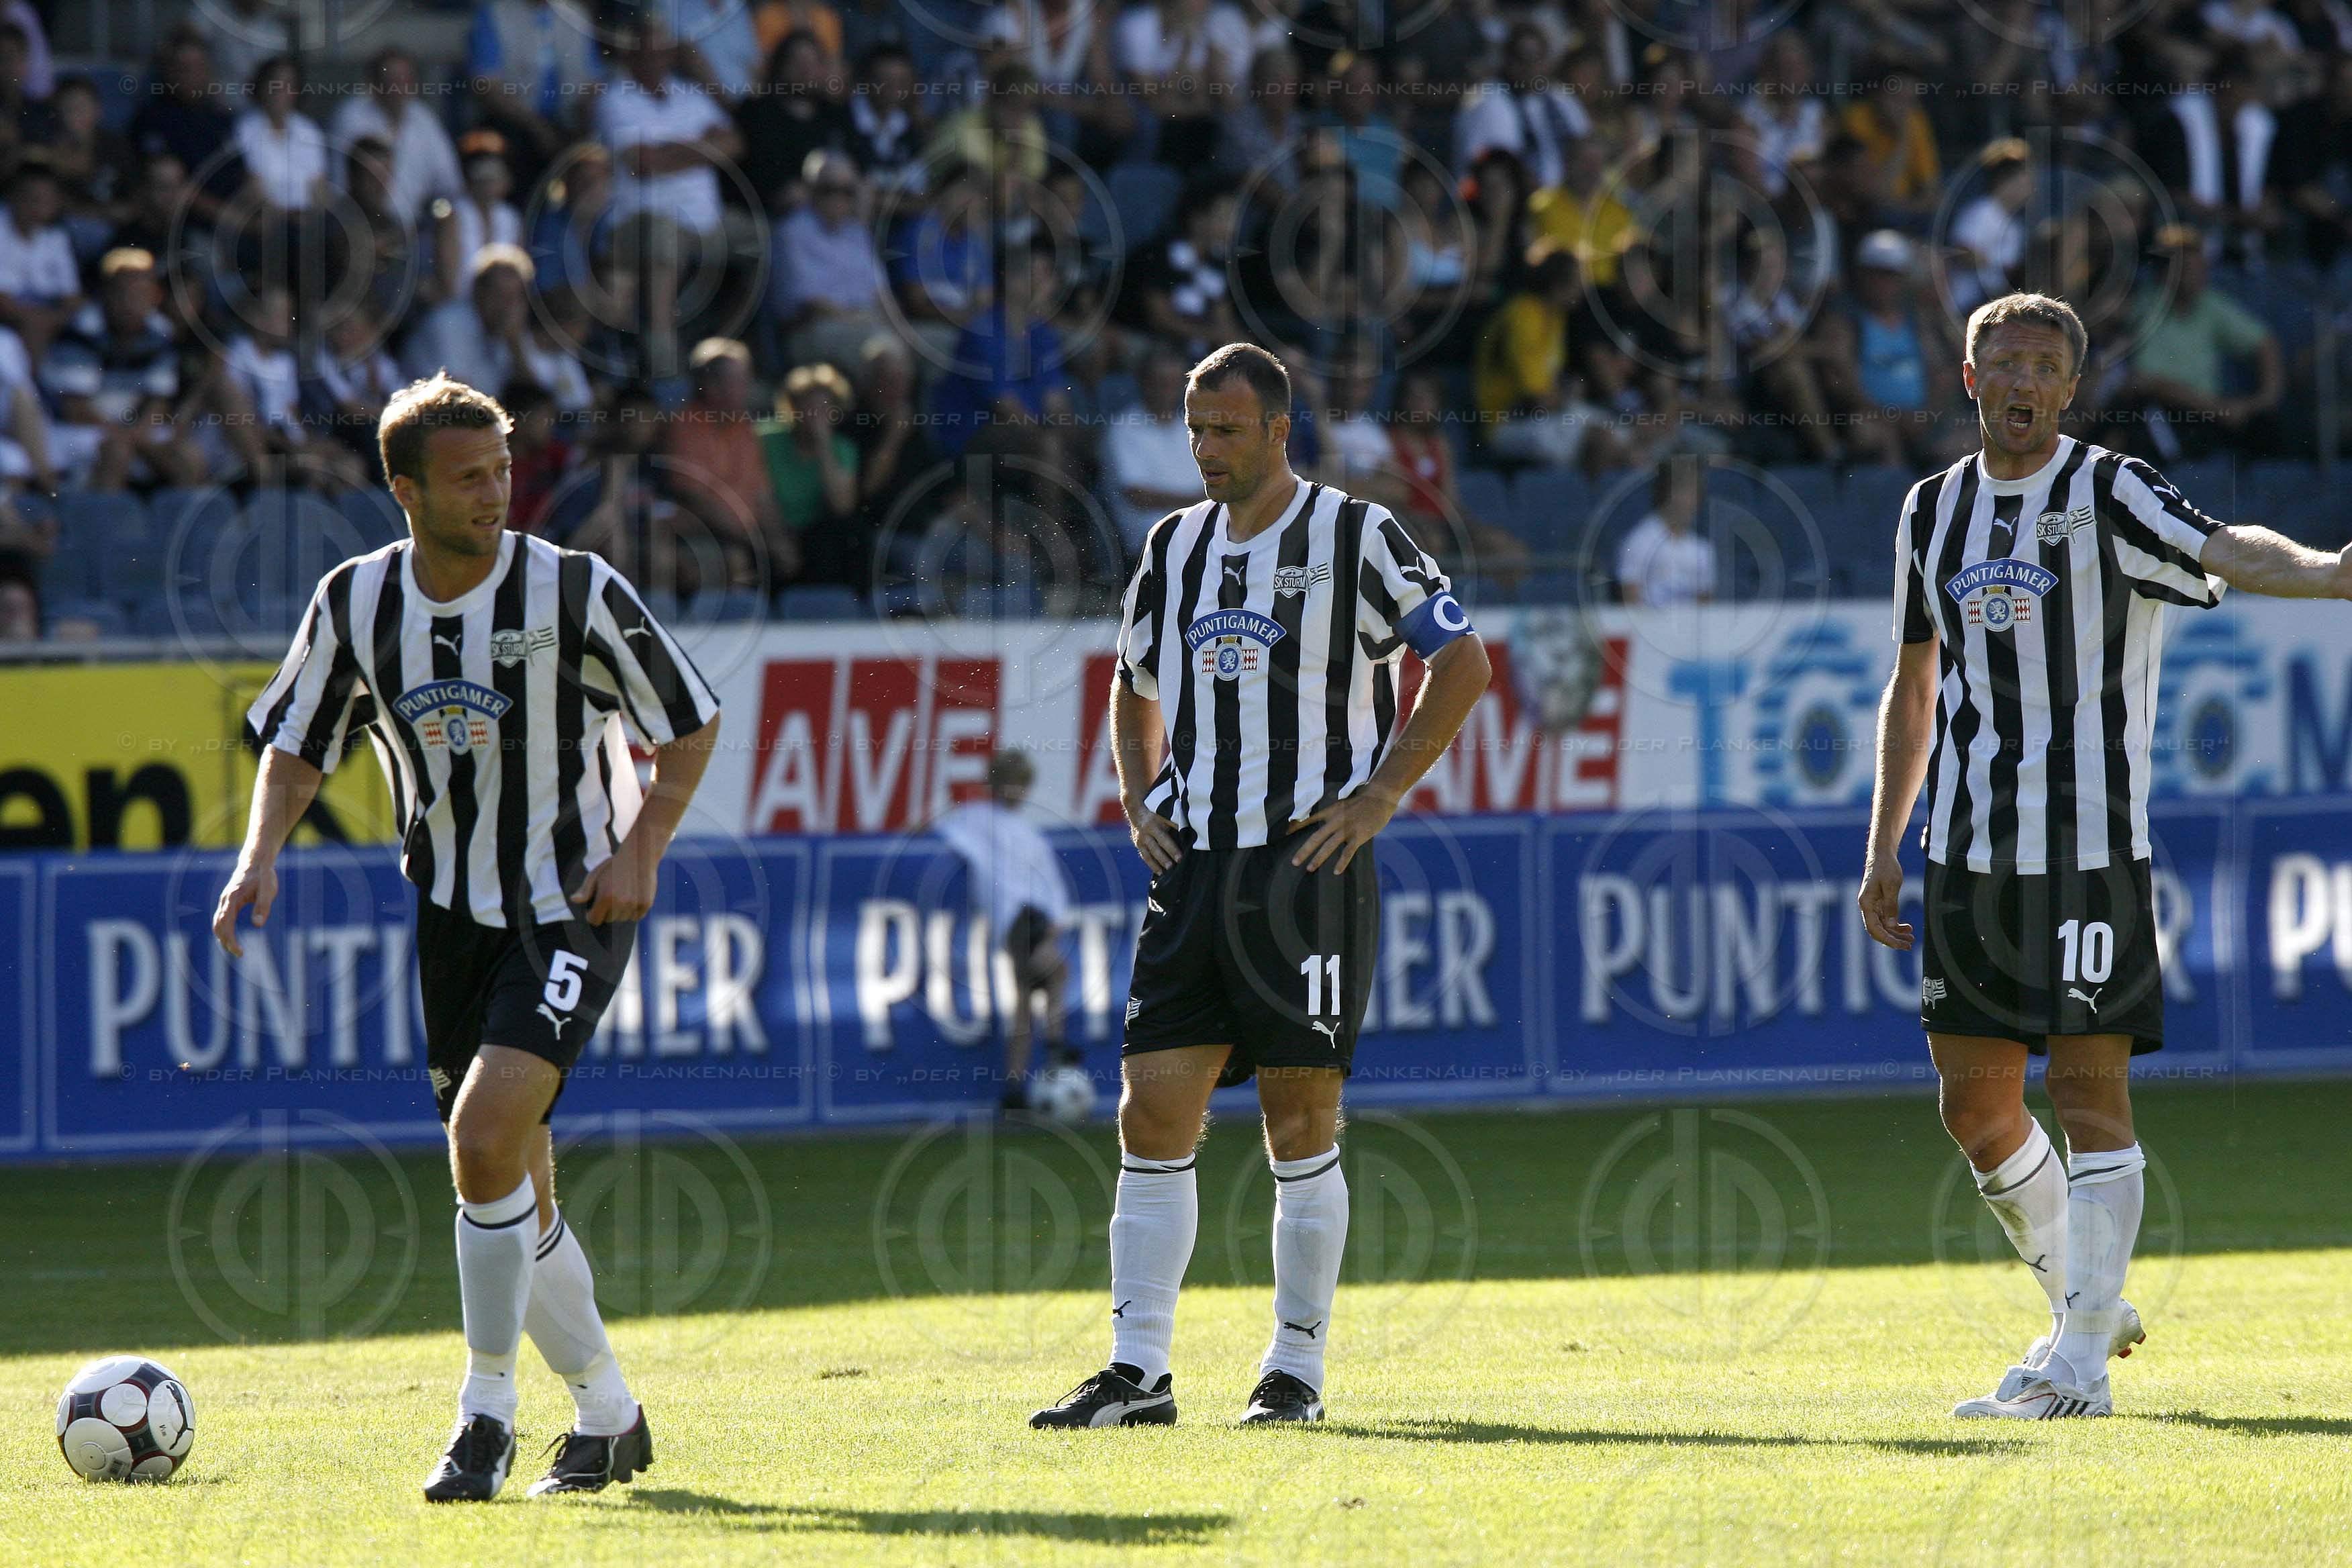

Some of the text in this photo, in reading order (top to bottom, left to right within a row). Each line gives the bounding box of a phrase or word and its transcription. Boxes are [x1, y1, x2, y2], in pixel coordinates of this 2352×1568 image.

[2037, 524, 2047, 538] SK
[1274, 575, 1306, 589] SK STURM
[1951, 564, 2051, 595] PUNTIGAMER
[1188, 615, 1279, 645] PUNTIGAMER
[1433, 595, 1469, 632] C
[399, 685, 505, 718] PUNTIGAMER
[2057, 919, 2114, 983] 10
[544, 949, 589, 1012] 5
[1301, 954, 1340, 1016] 11
